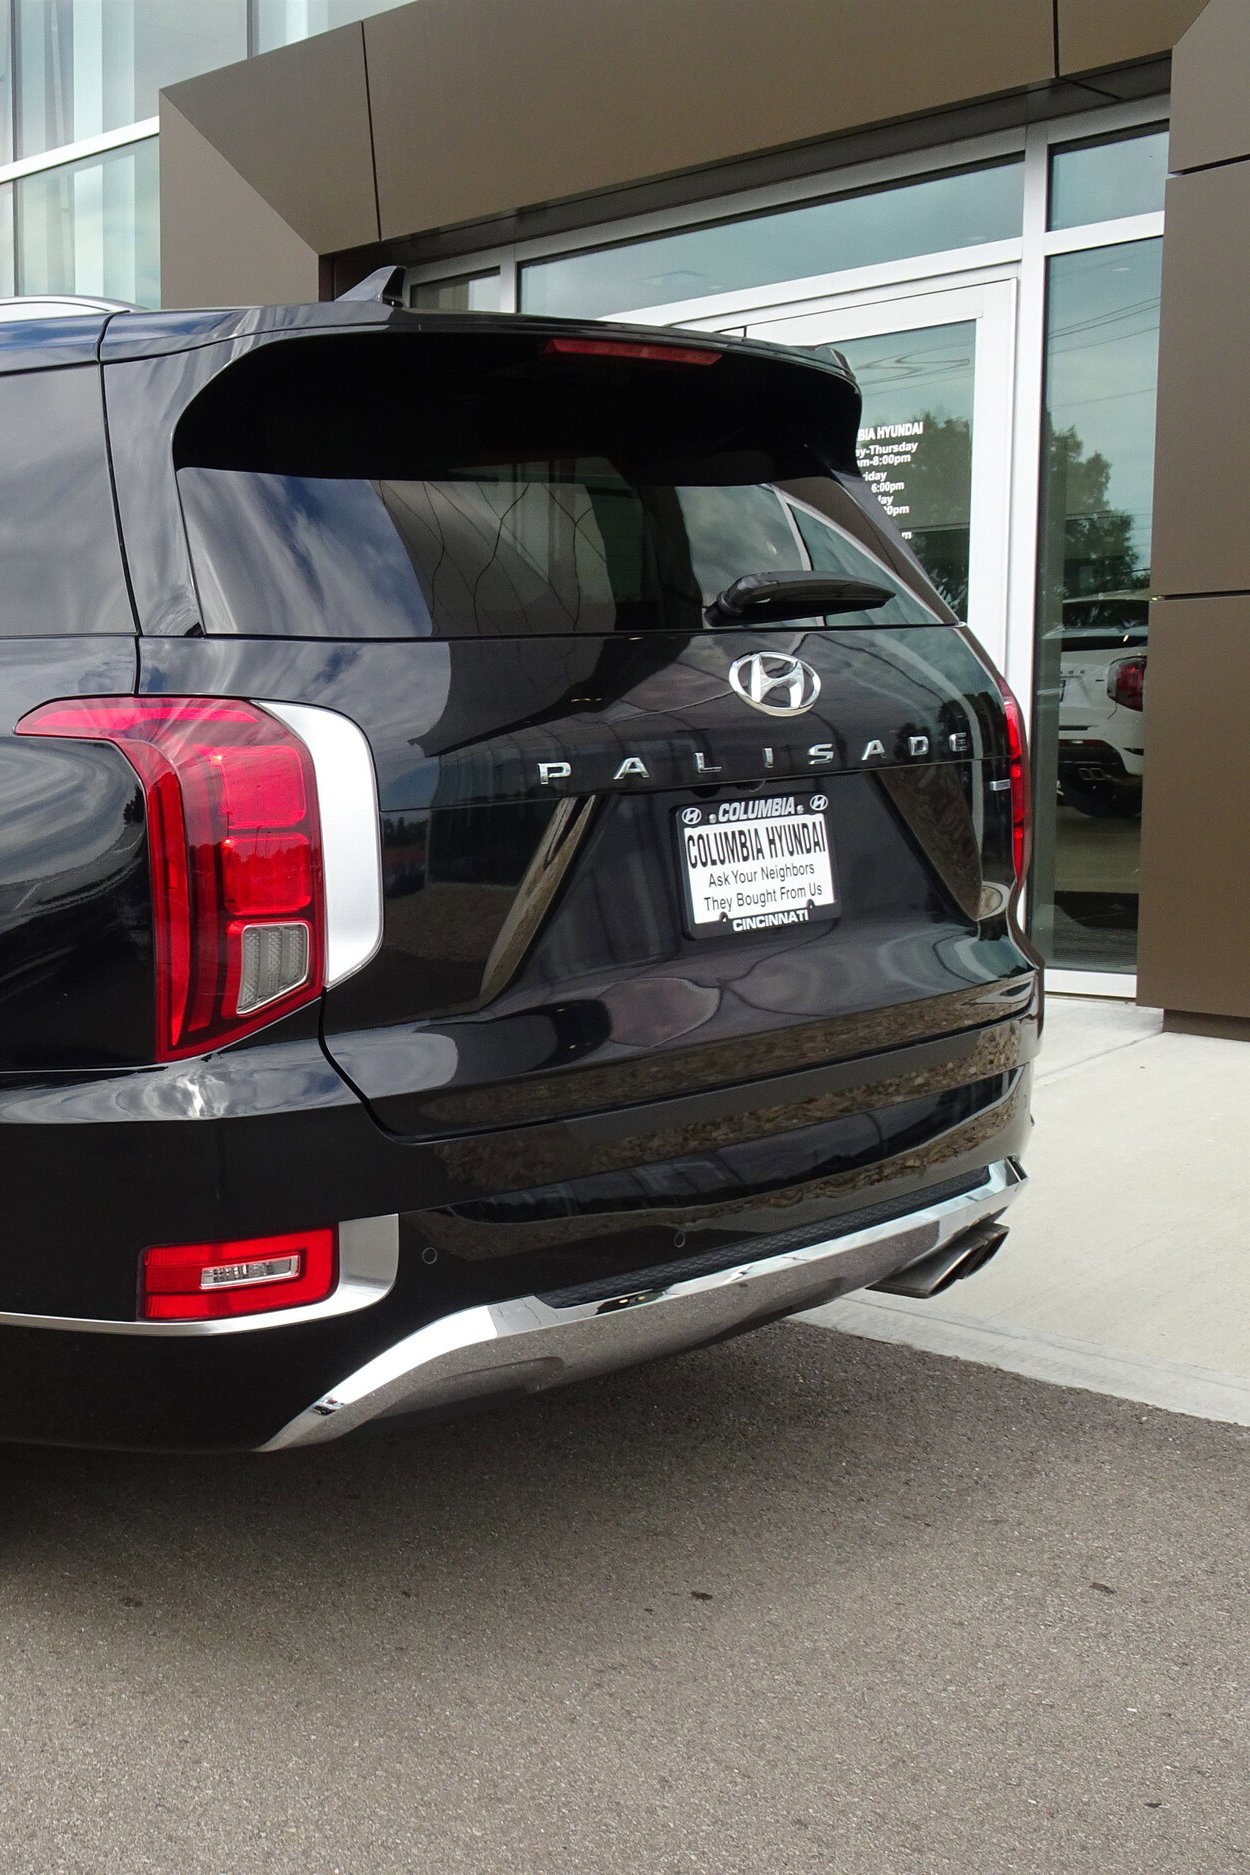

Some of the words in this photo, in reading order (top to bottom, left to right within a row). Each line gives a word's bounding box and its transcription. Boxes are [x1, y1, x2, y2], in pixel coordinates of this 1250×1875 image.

[876, 421, 924, 439] HYUNDAI
[538, 732, 968, 785] PALISADE
[718, 797, 796, 823] COLUMBIA
[687, 828, 765, 869] COLUMBIA
[766, 821, 826, 858] HYUNDAI
[708, 871, 731, 888] Ask
[731, 869, 758, 884] Your
[761, 863, 815, 883] Neighbors
[704, 896, 733, 913] They
[736, 889, 777, 908] Bought
[780, 886, 807, 900] From
[808, 882, 823, 896] Us
[732, 909, 809, 932] CINCINNATI
